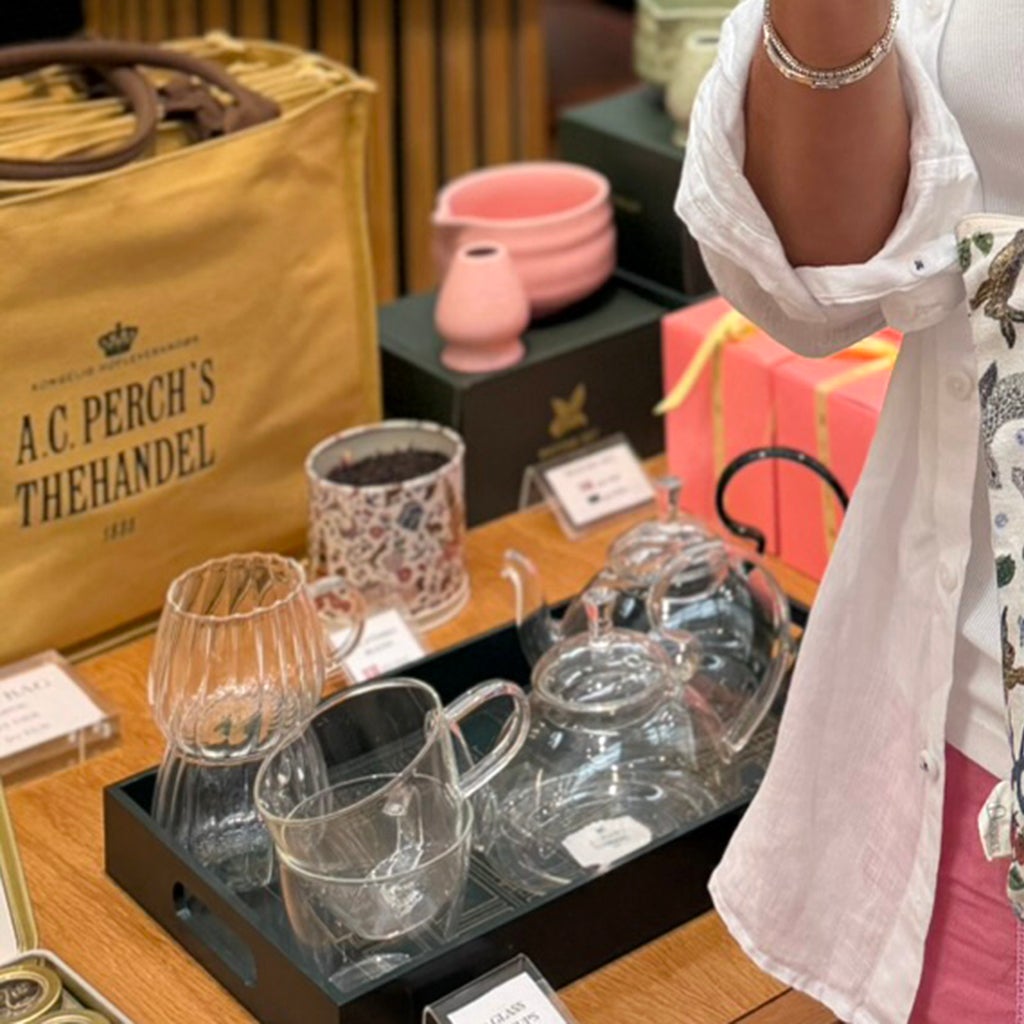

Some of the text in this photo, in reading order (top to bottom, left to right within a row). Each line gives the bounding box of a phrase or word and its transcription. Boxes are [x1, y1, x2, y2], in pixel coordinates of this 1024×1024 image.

[15, 358, 217, 466] A.C. PERCH'S
[15, 424, 217, 527] THEHANDEL
